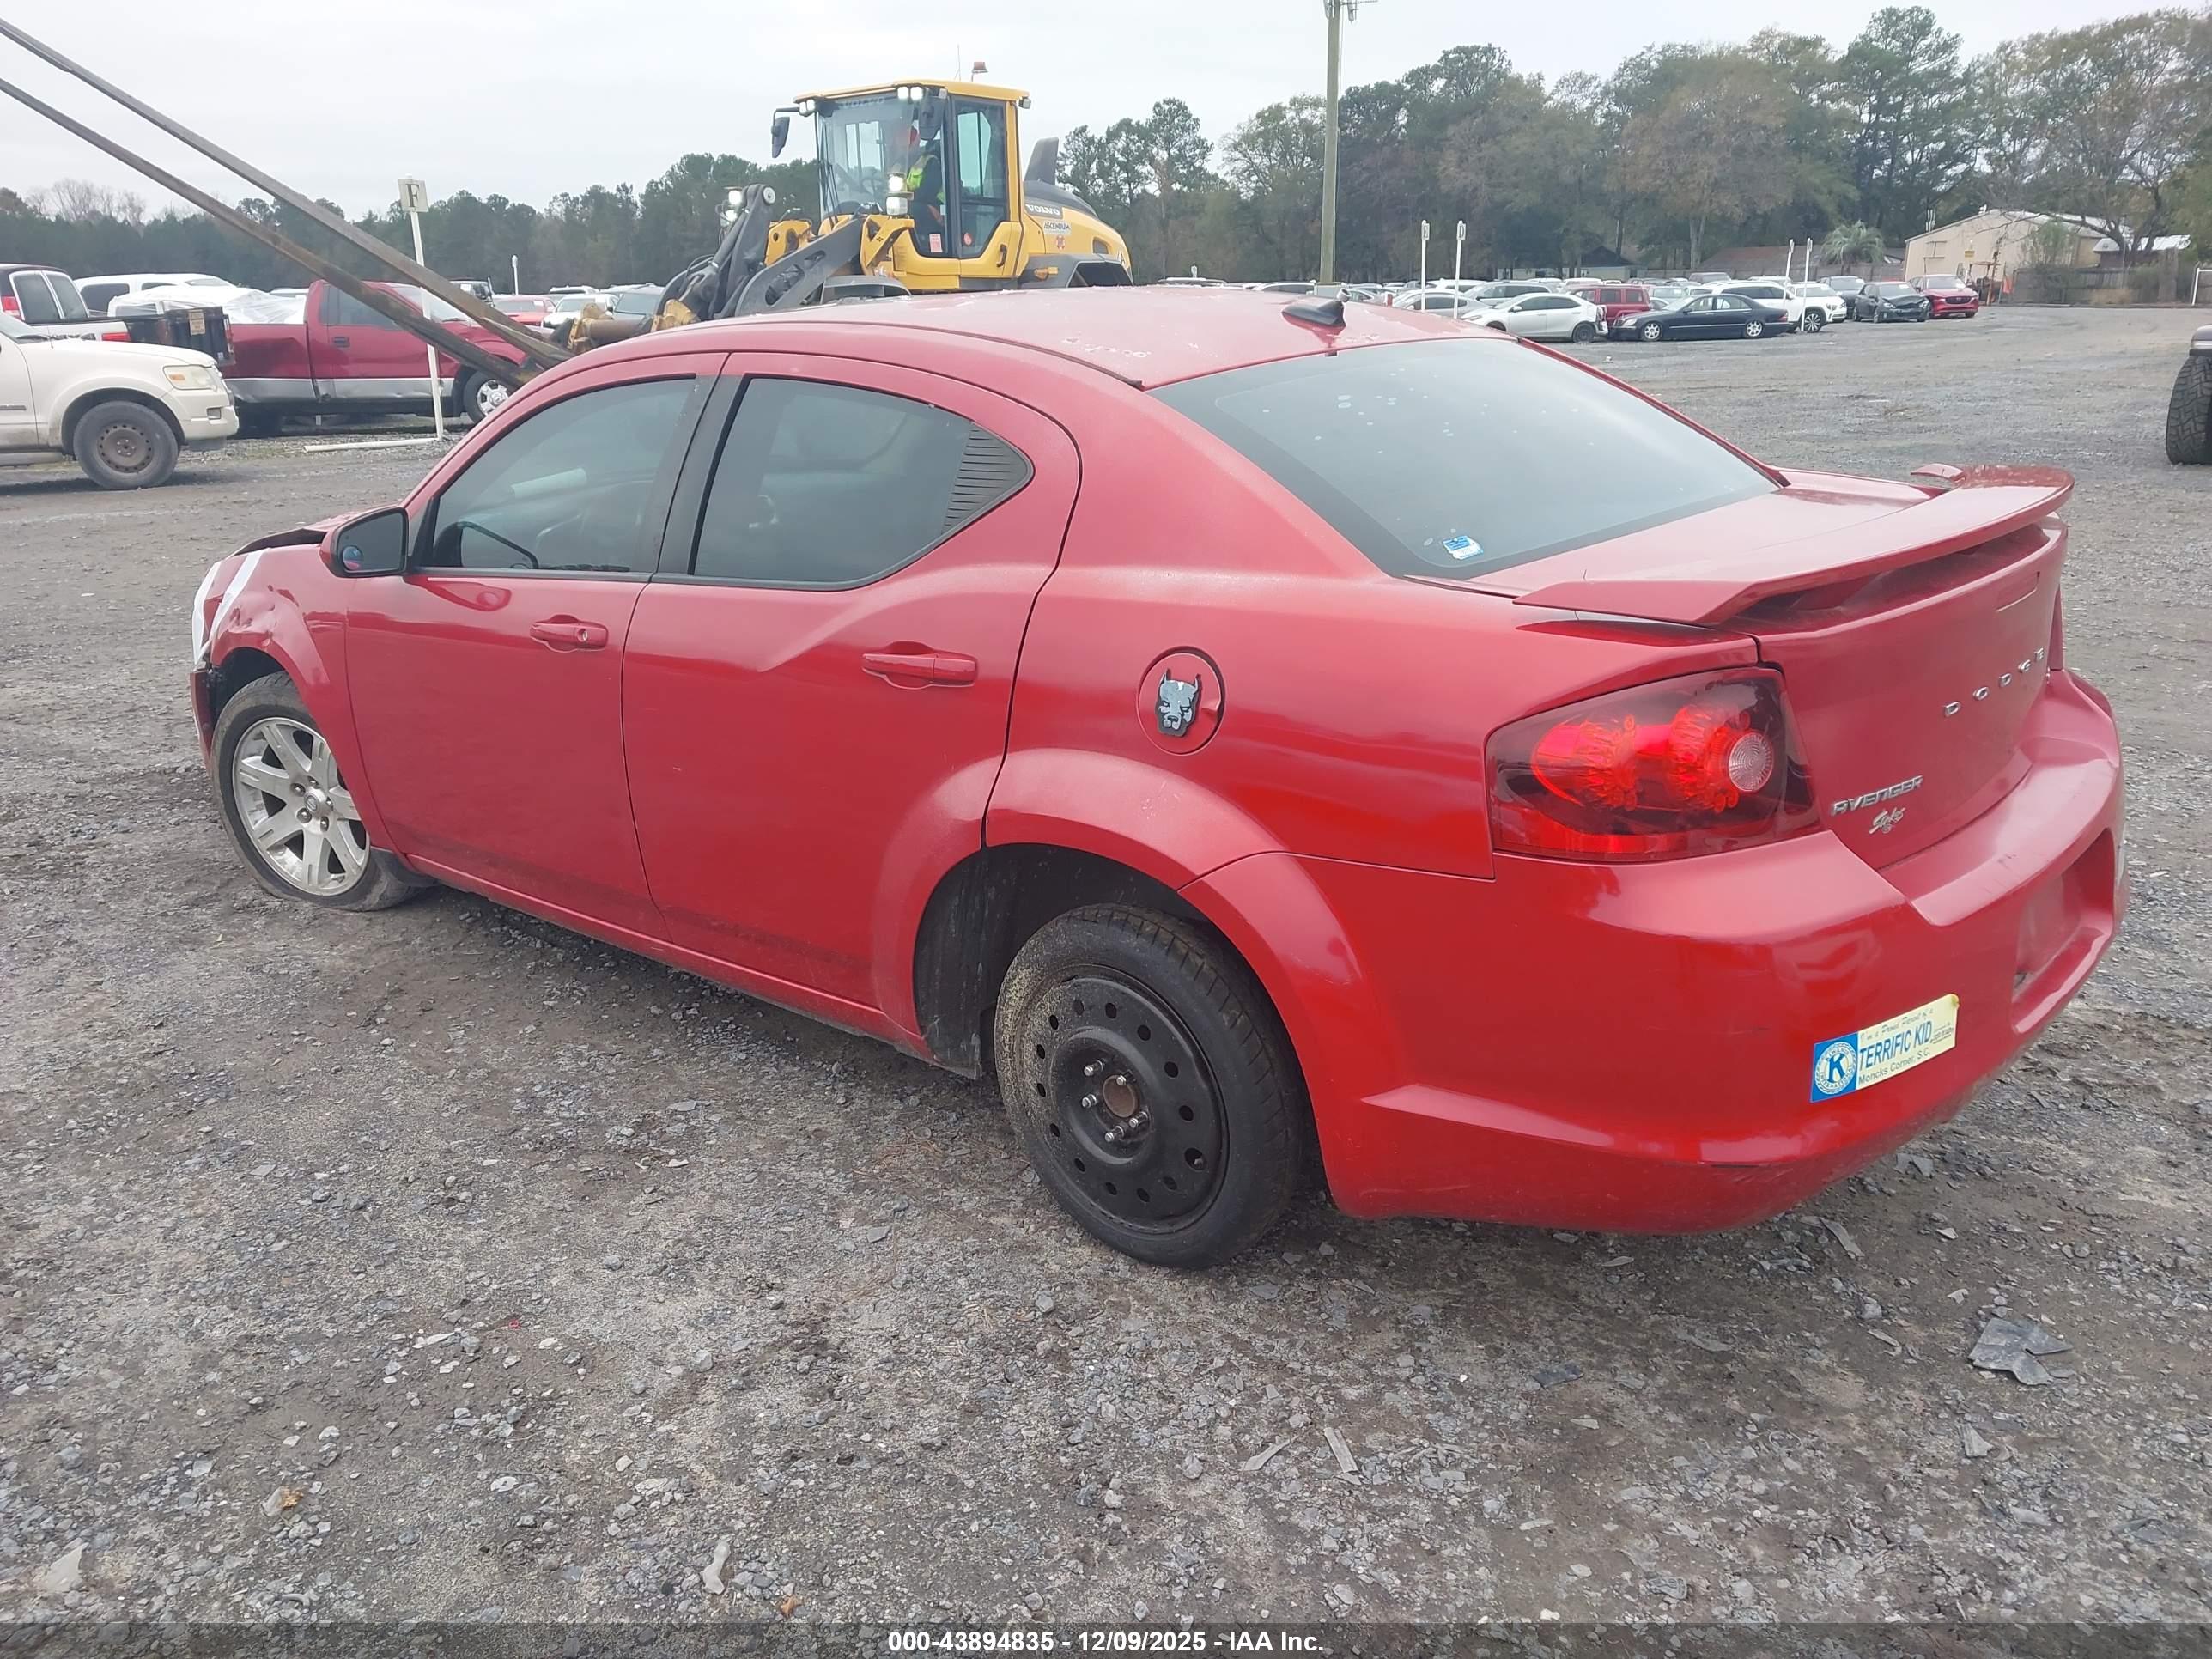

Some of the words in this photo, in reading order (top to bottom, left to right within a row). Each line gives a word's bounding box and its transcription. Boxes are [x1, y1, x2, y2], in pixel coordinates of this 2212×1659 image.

[405, 183, 419, 208] F
[1025, 204, 1060, 216] VOLVO
[1944, 647, 2045, 718] DODGE
[1831, 774, 1923, 817] AVENGER
[1859, 1029, 1911, 1071] TERRIFIC
[1913, 1020, 1933, 1048] KID
[1827, 1053, 1846, 1084] K
[1858, 1067, 1888, 1085] Moncks
